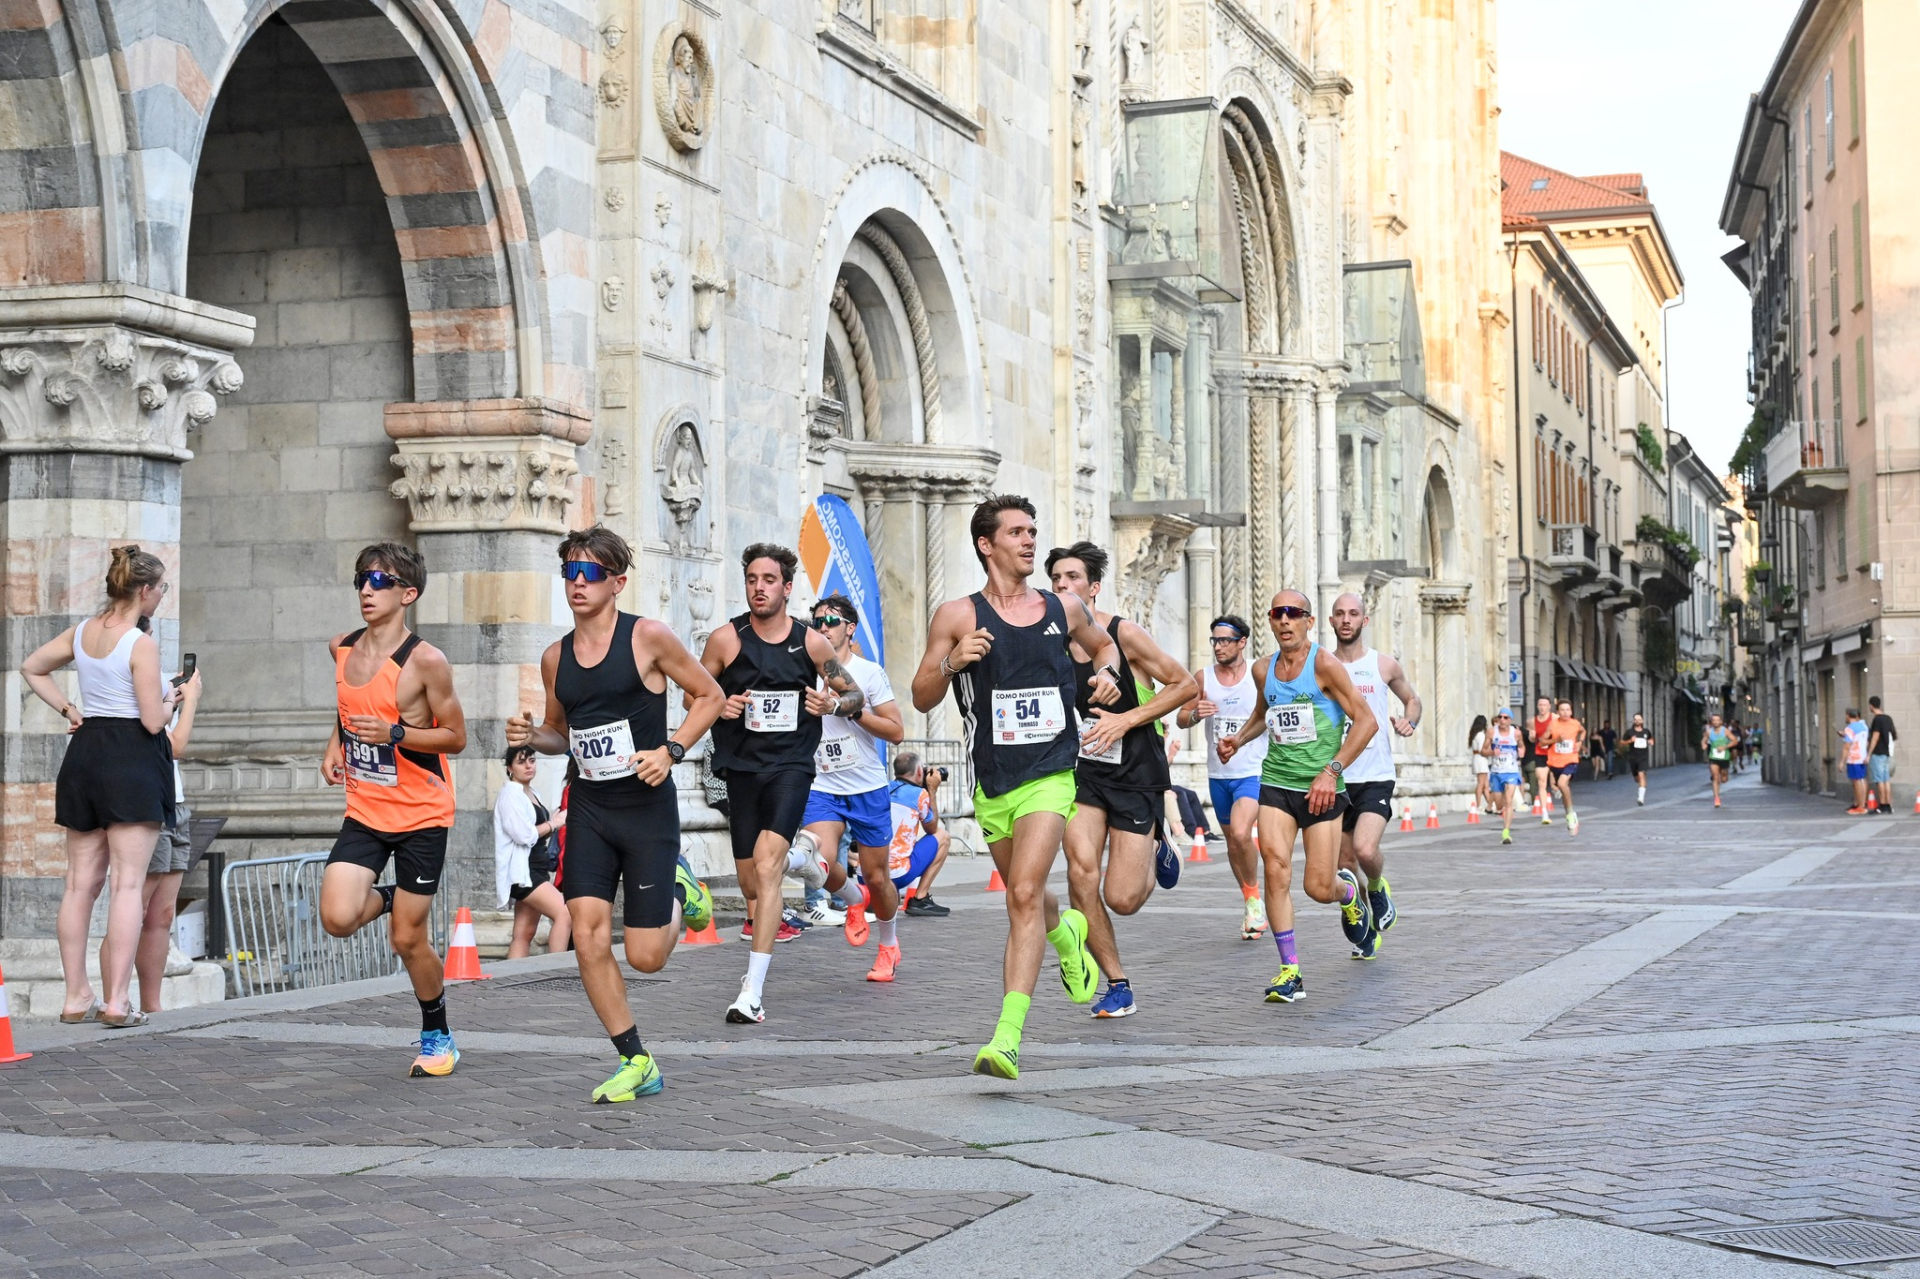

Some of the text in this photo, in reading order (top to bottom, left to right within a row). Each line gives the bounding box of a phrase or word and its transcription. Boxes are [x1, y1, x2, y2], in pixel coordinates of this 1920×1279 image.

[995, 692, 1017, 700] COMO
[1018, 690, 1040, 698] NIGHT
[762, 698, 781, 714] 52
[1015, 698, 1041, 720] 54
[1018, 720, 1039, 728] TOMMASO
[1276, 711, 1300, 727] 135
[584, 729, 606, 739] NIGHT
[606, 725, 623, 733] RUN
[1225, 721, 1238, 733] 75
[352, 740, 380, 764] 591
[578, 735, 617, 759] 202
[825, 743, 842, 757] 98
